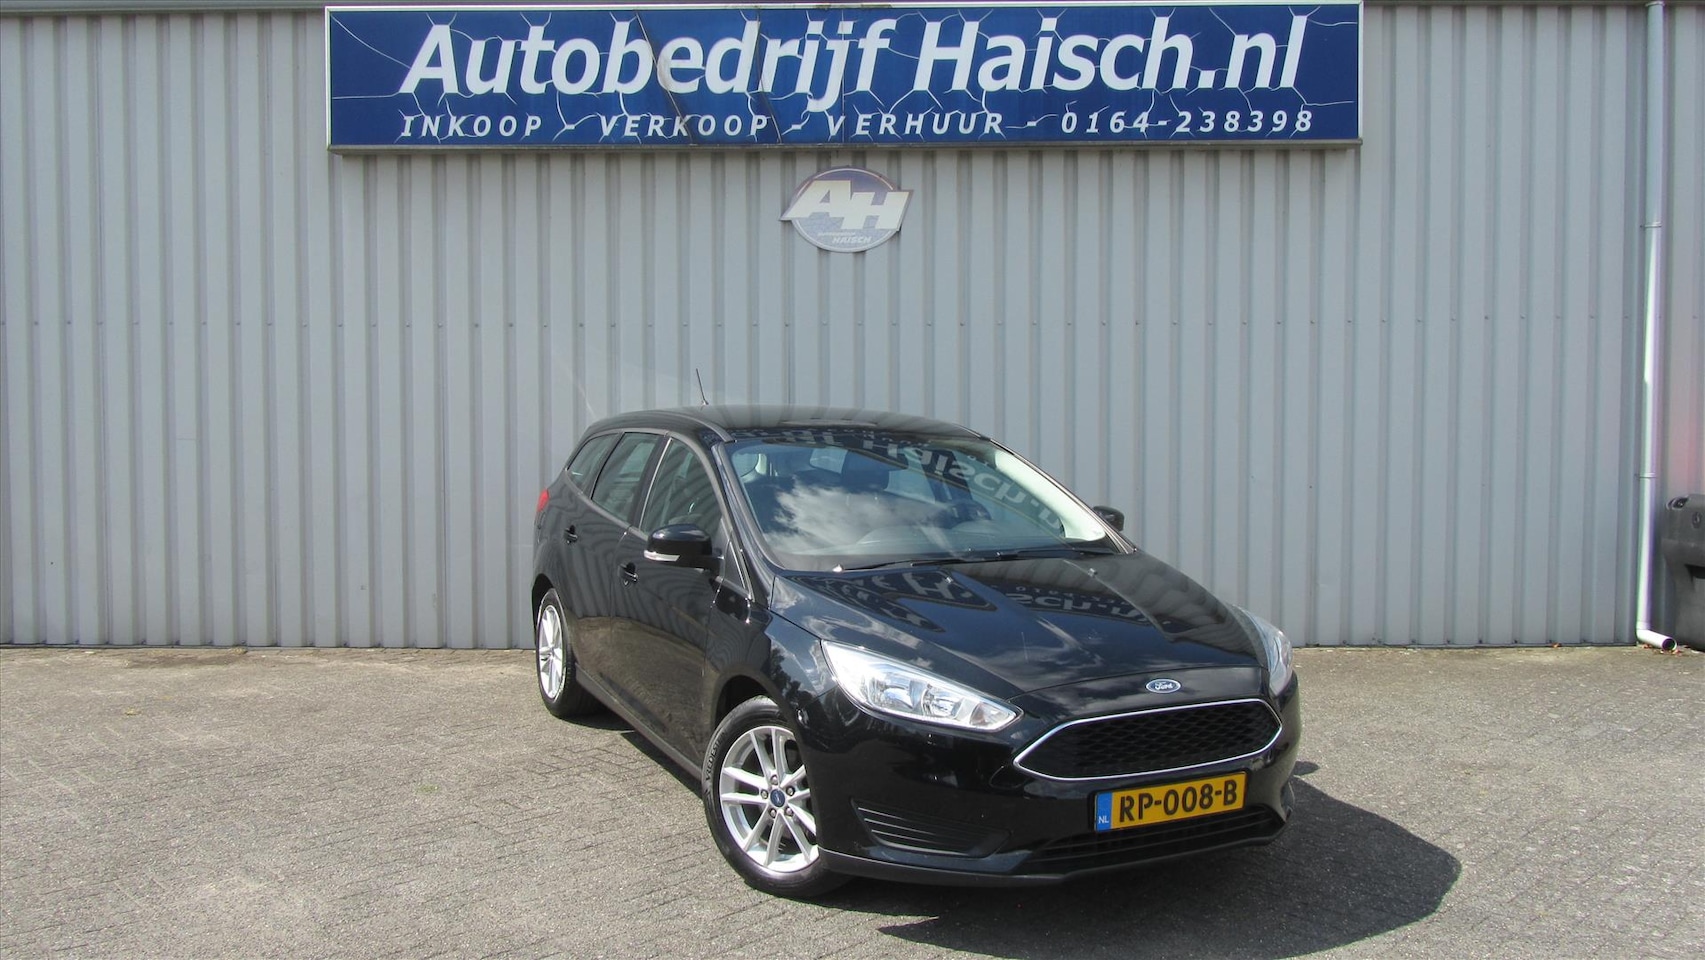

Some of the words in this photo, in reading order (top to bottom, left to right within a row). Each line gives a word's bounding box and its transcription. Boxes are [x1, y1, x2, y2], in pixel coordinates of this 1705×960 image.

[399, 19, 896, 113] Autobedrijf
[912, 15, 1309, 92] Haisch.nl
[402, 115, 543, 137] INKOOP
[601, 115, 769, 137] VERKOOP
[827, 112, 1003, 136] VERHUUR
[1061, 110, 1313, 133] 0164-238398
[782, 180, 910, 230] AH
[1098, 815, 1110, 824] NL
[1119, 779, 1238, 823] RP-008-B
